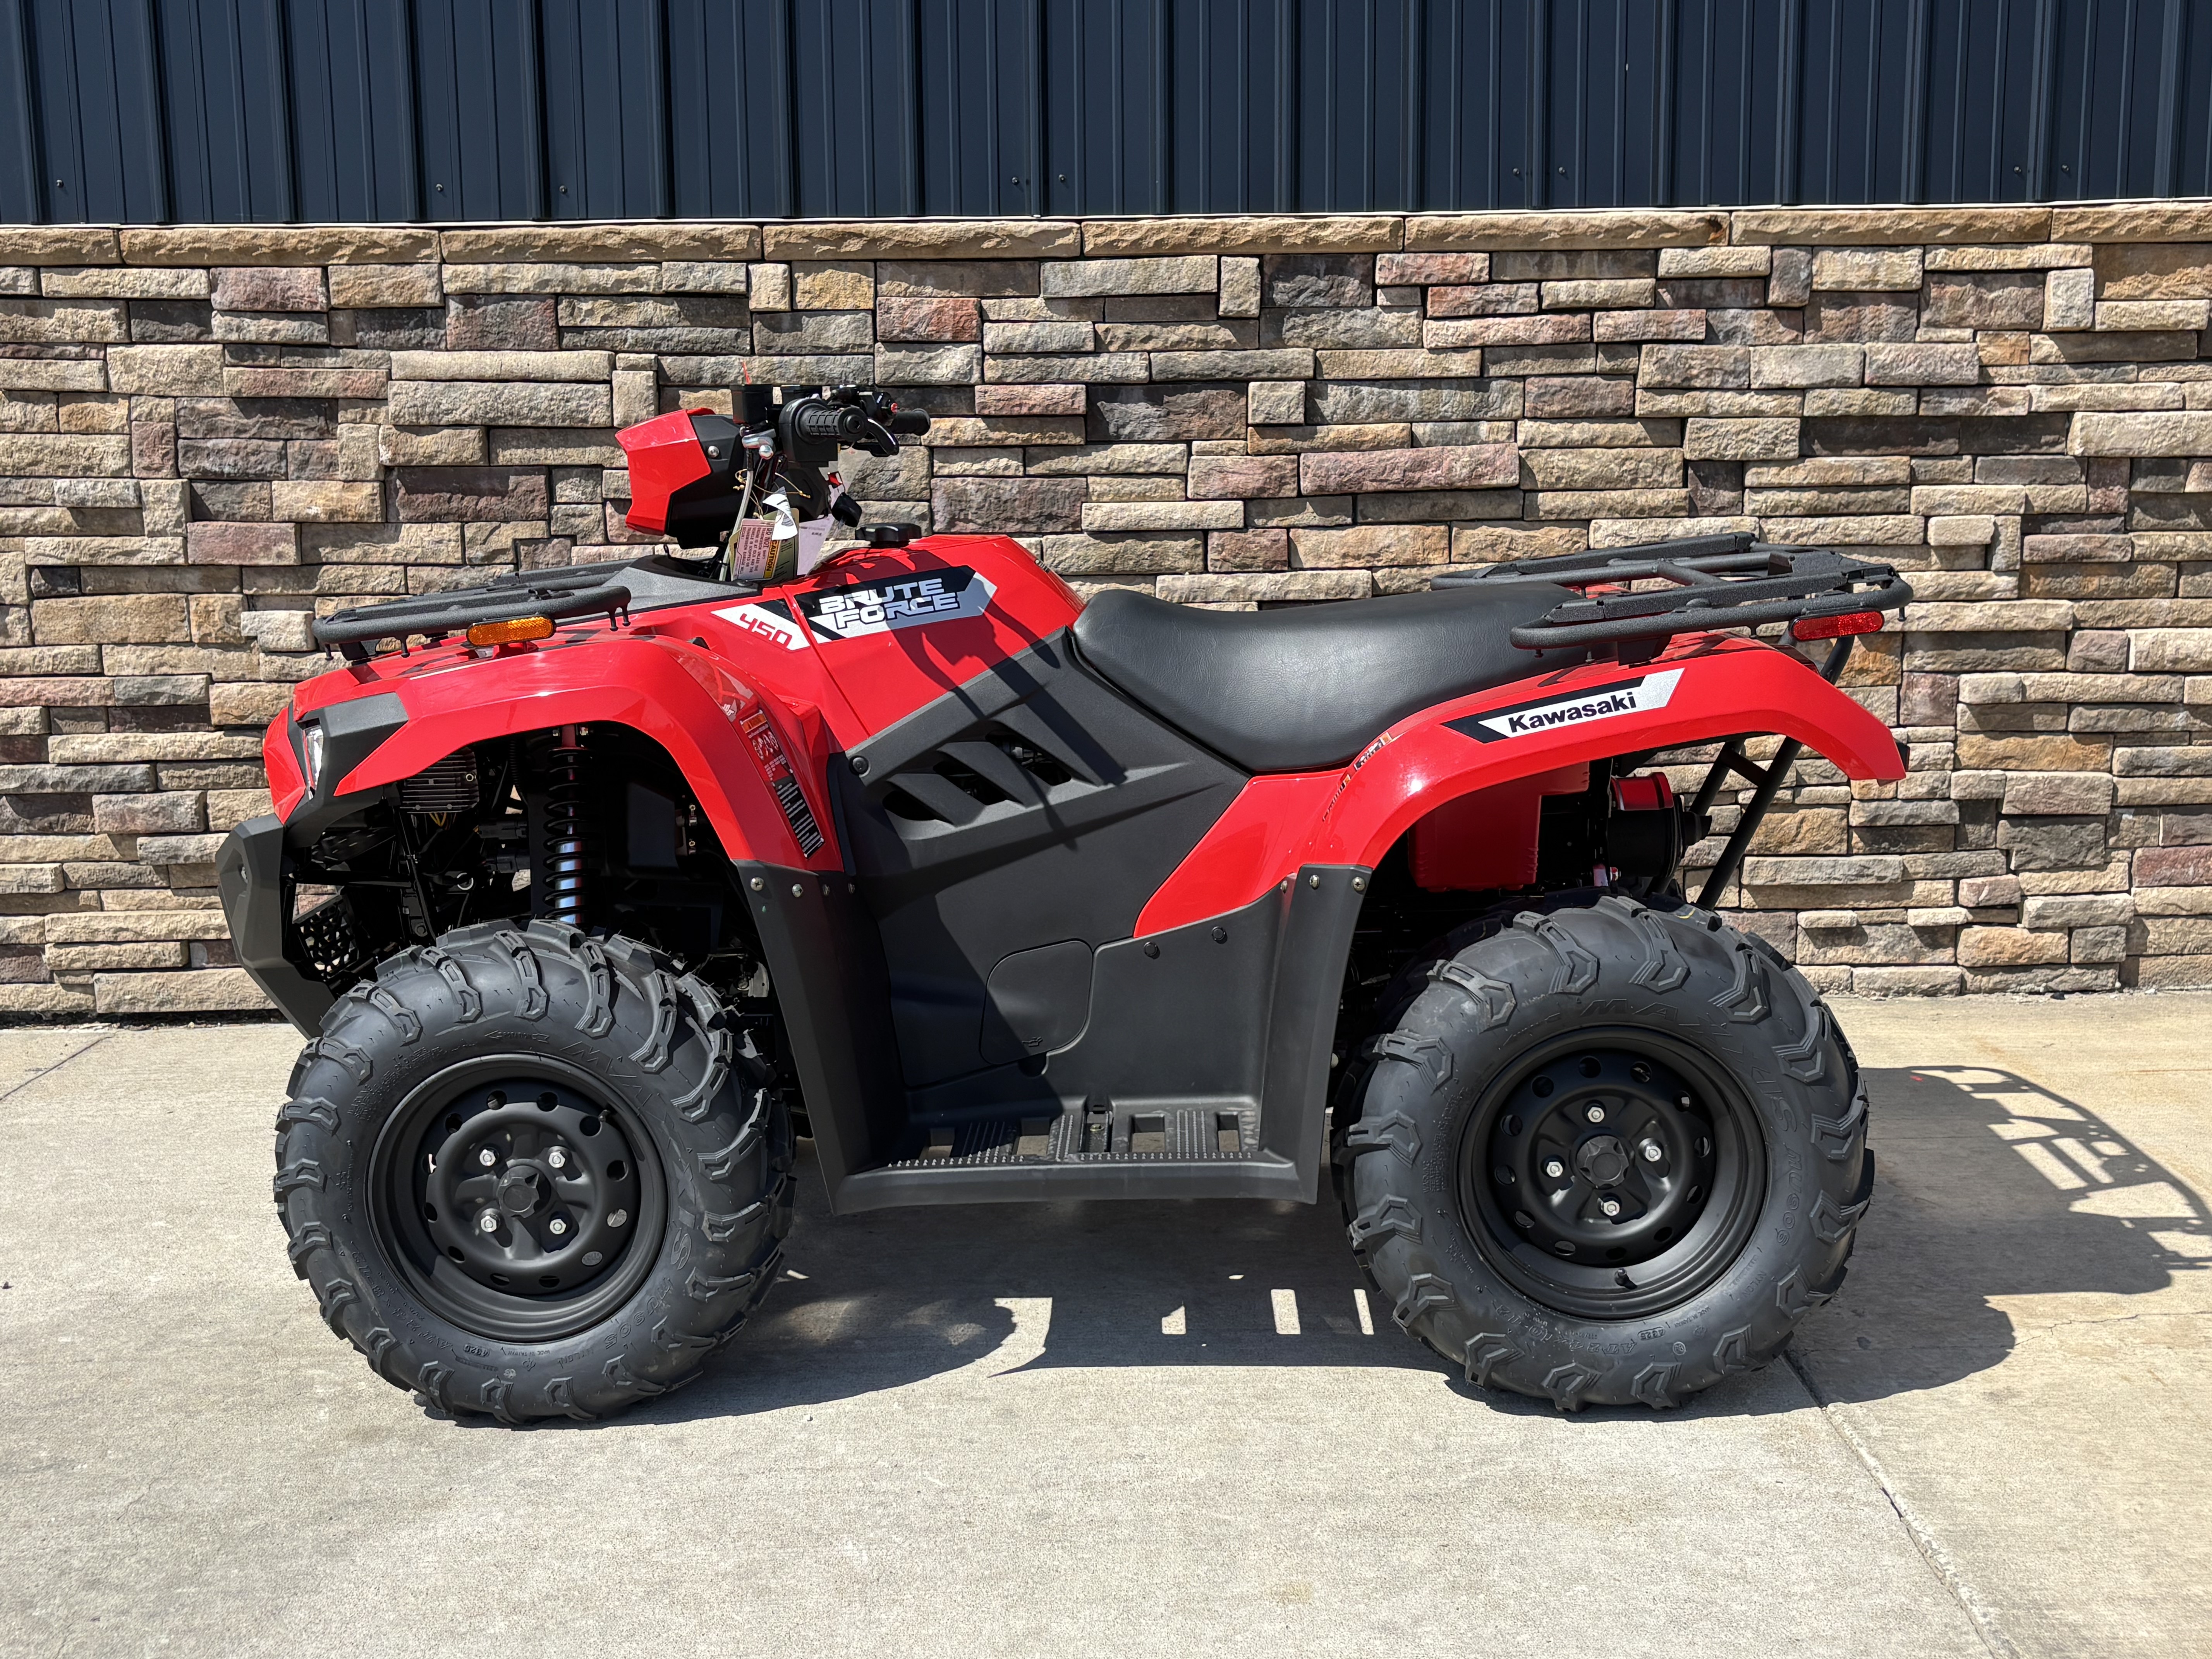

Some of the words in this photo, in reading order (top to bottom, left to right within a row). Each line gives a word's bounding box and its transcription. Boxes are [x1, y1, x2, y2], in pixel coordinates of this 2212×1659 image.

[766, 541, 777, 571] CAUTION
[819, 578, 945, 614] BRUTE
[834, 592, 959, 629] FORCE
[740, 613, 793, 648] 450
[1508, 691, 1637, 733] Kawasaki
